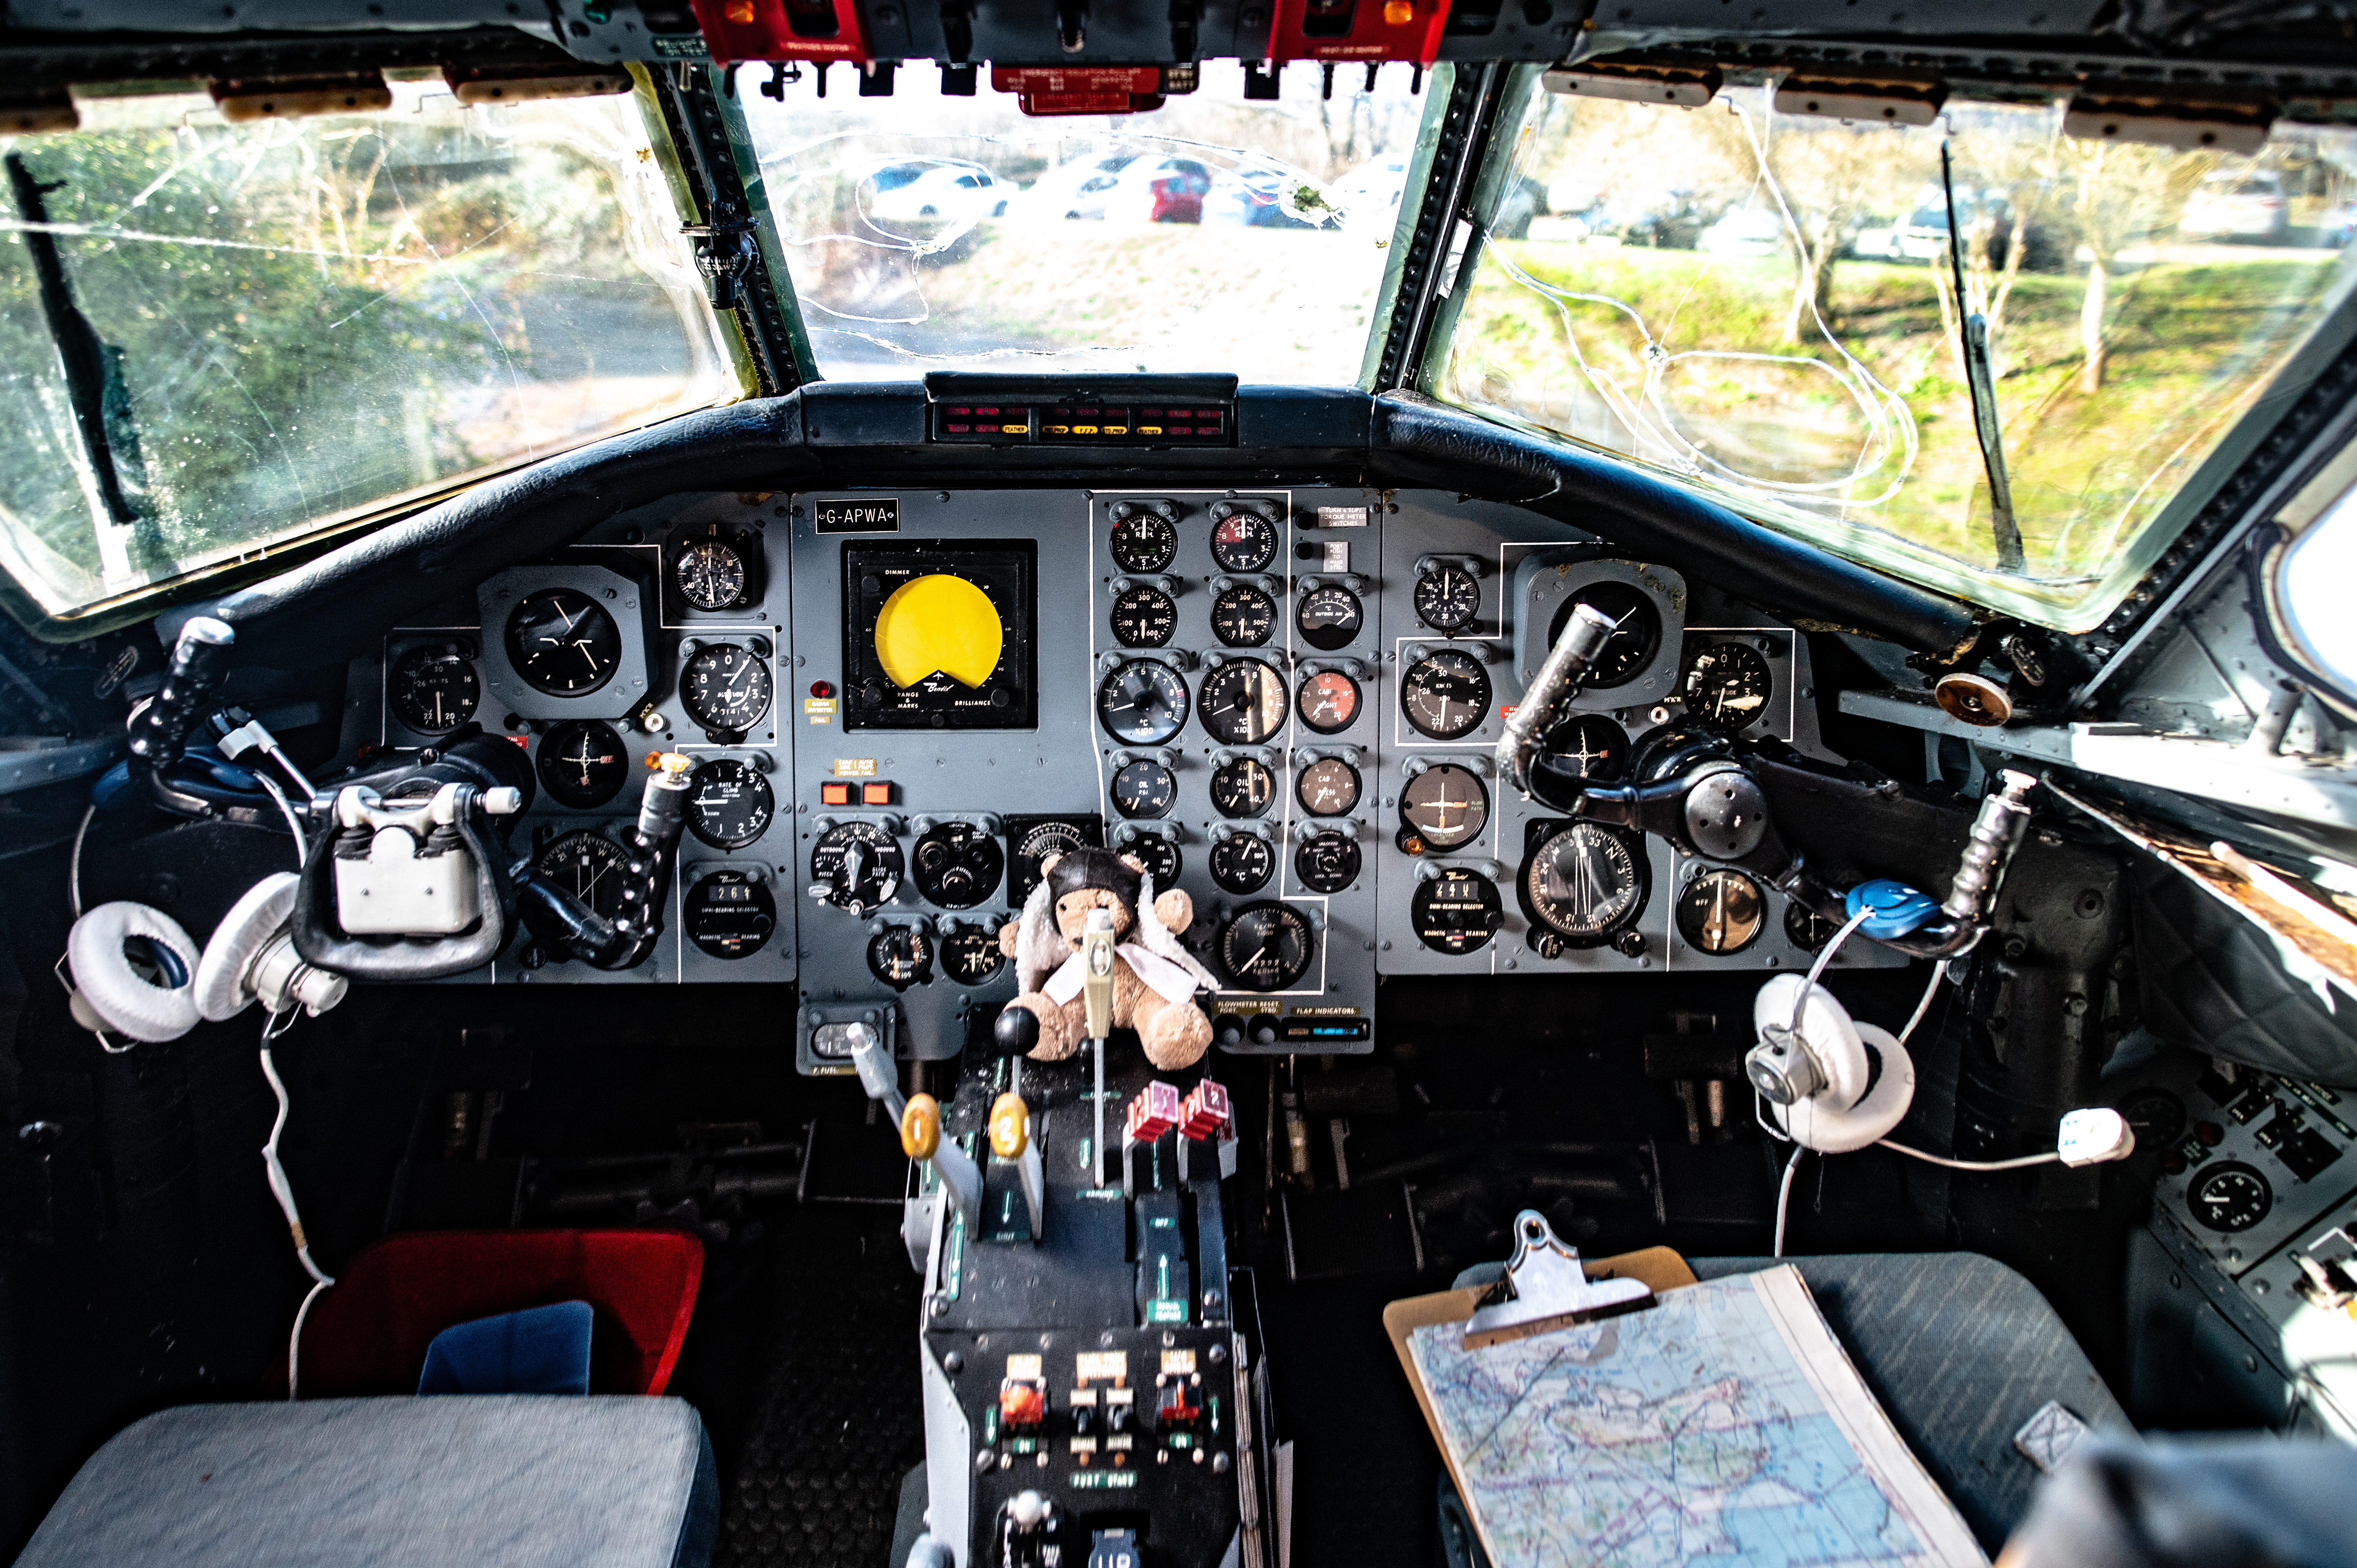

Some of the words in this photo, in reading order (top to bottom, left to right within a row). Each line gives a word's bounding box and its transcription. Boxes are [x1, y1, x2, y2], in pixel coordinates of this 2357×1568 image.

[827, 508, 886, 523] G-APWA
[725, 655, 732, 664] 0
[1721, 654, 1727, 663] 0
[700, 674, 707, 683] 8
[751, 673, 757, 683] 2
[1744, 672, 1750, 681] 2
[923, 682, 954, 692] Bendix
[1745, 688, 1750, 696] 3
[701, 690, 708, 700] 7
[752, 689, 758, 699] 3
[1696, 688, 1702, 697] 7
[1705, 701, 1710, 710] 6
[1589, 837, 1601, 847] 33
[1606, 846, 1618, 860] N
[1540, 863, 1550, 875] 24
[1605, 904, 1613, 913] E
[914, 1119, 920, 1141] 1
[1000, 1116, 1012, 1142] 2
